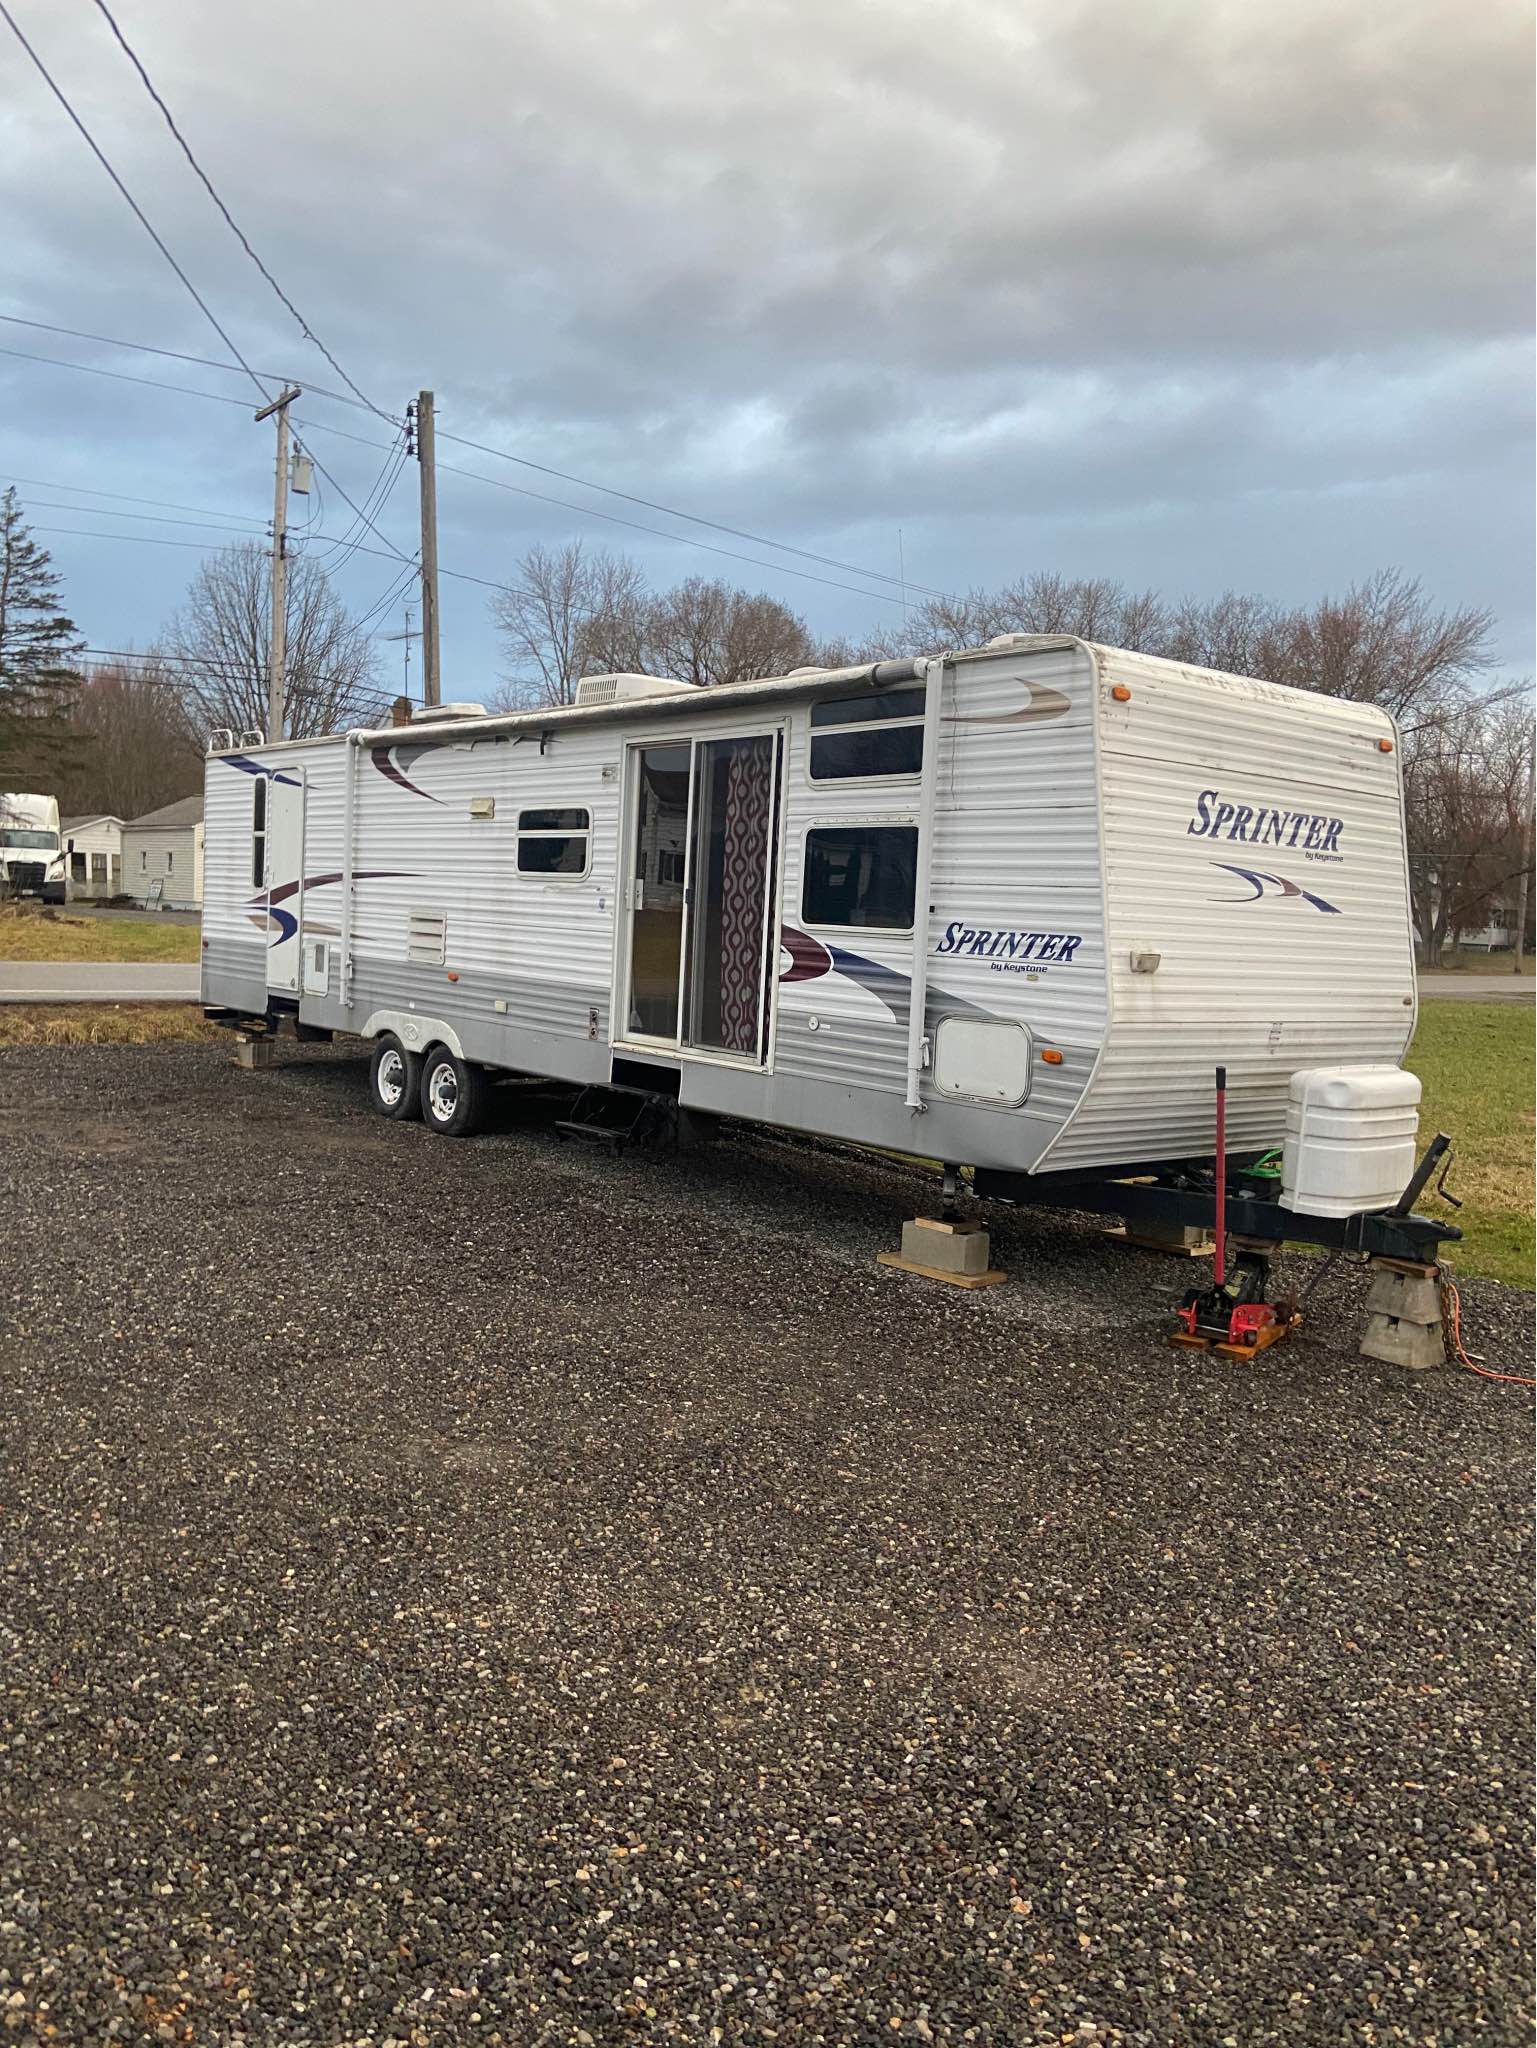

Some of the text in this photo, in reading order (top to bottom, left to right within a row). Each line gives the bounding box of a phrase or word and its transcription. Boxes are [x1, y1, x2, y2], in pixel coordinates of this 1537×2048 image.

[1187, 789, 1344, 852] SPRINTER
[1305, 851, 1314, 861] by
[934, 921, 1083, 962] SPRINTER
[990, 961, 1048, 974] by Keystone
